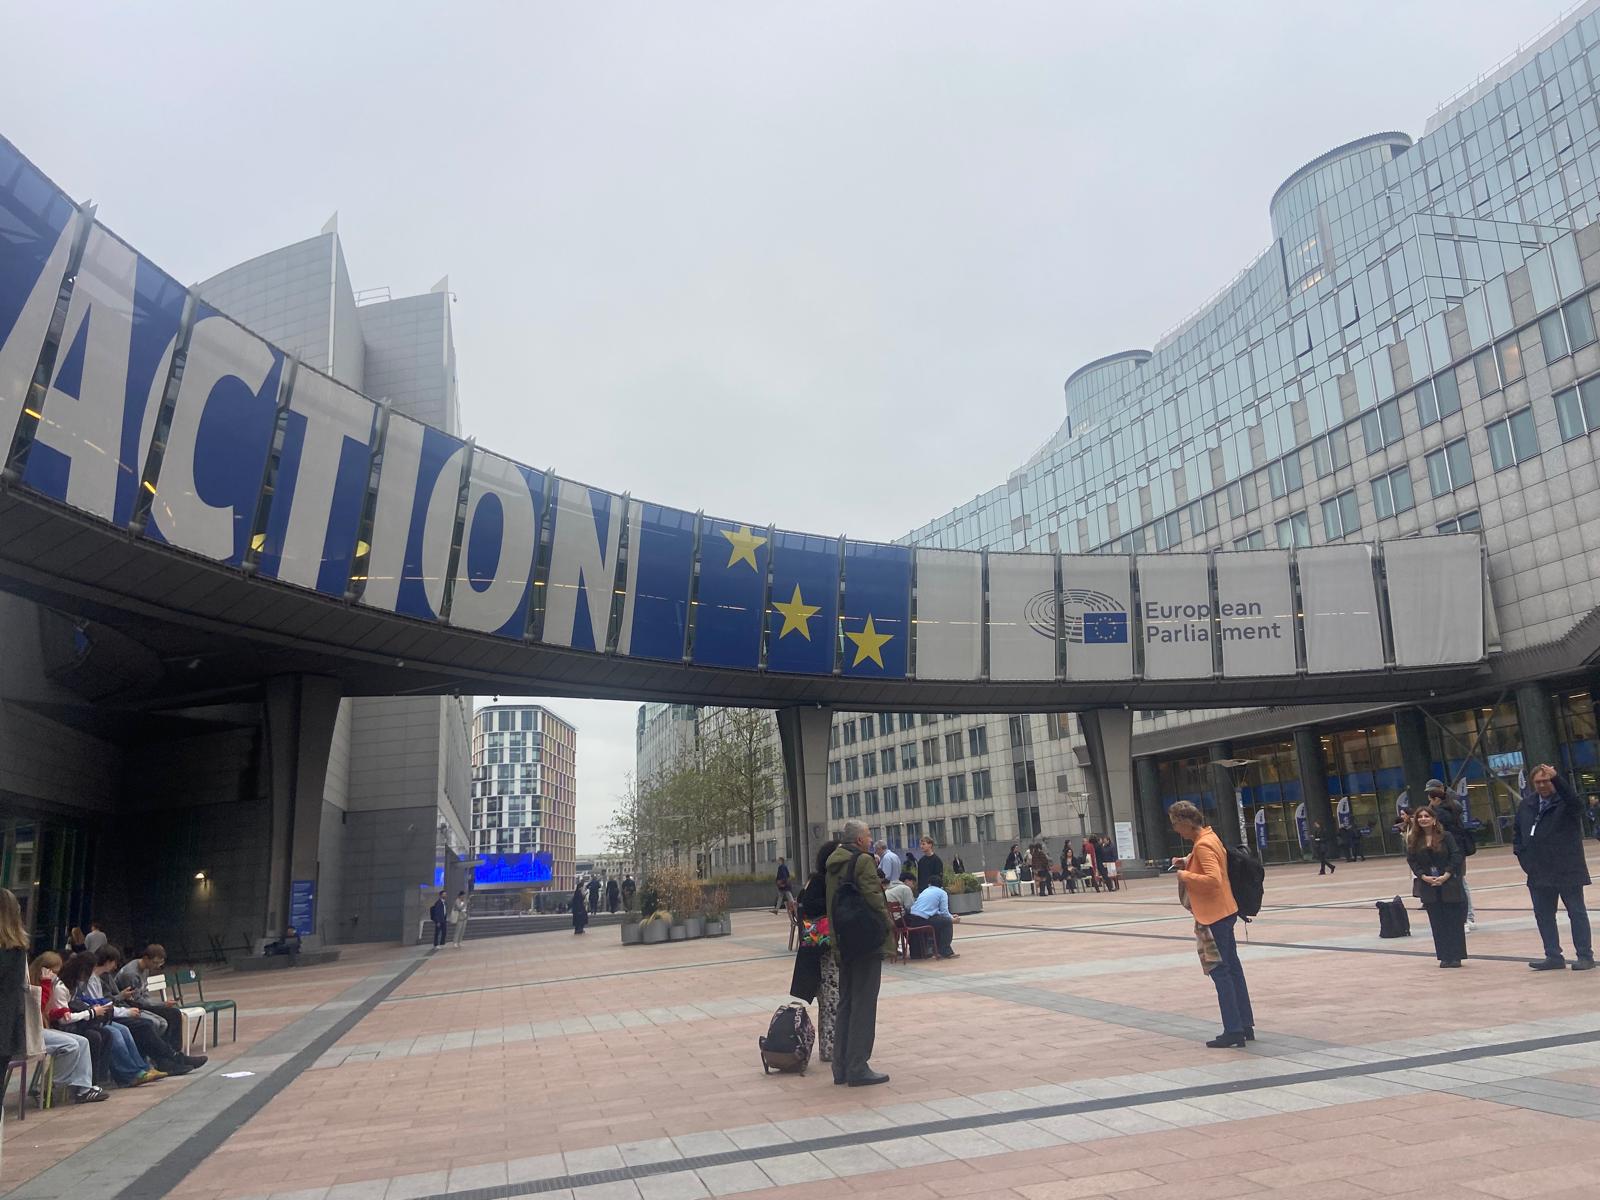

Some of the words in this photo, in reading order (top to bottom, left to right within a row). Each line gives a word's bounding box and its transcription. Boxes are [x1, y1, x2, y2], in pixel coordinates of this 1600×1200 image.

[0, 208, 641, 653] ACTION
[1145, 602, 1262, 620] European
[1146, 623, 1281, 643] Parliament
